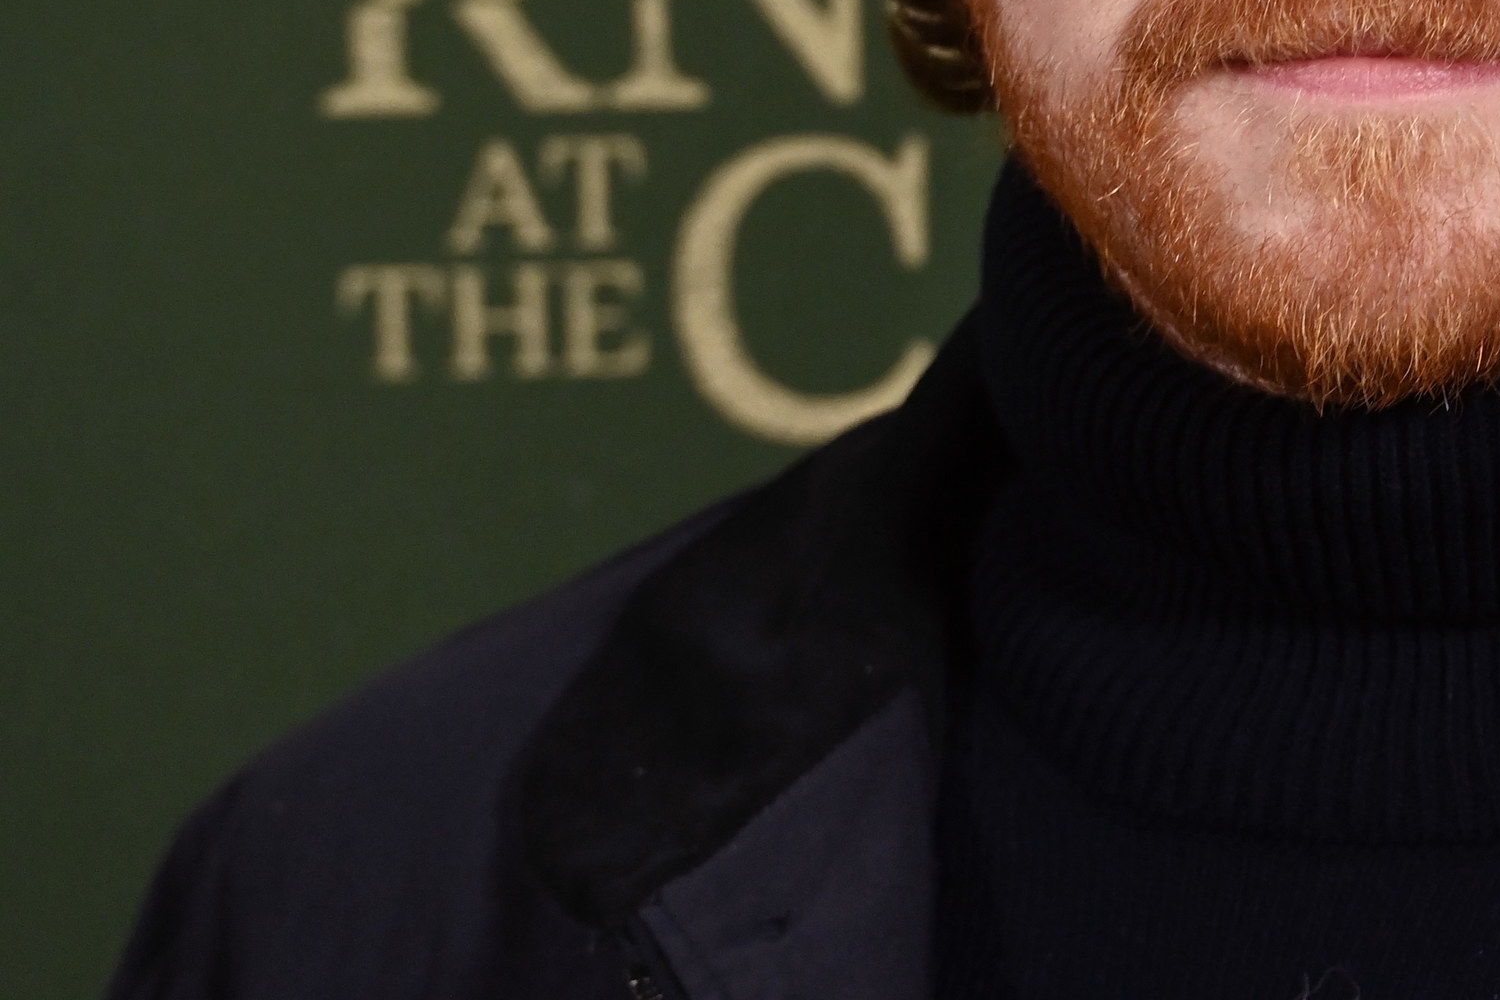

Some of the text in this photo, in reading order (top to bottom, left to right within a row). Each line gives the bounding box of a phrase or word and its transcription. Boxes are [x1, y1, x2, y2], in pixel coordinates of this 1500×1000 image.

[449, 134, 646, 251] AT
[337, 261, 650, 380] THE
[673, 133, 934, 443] C
